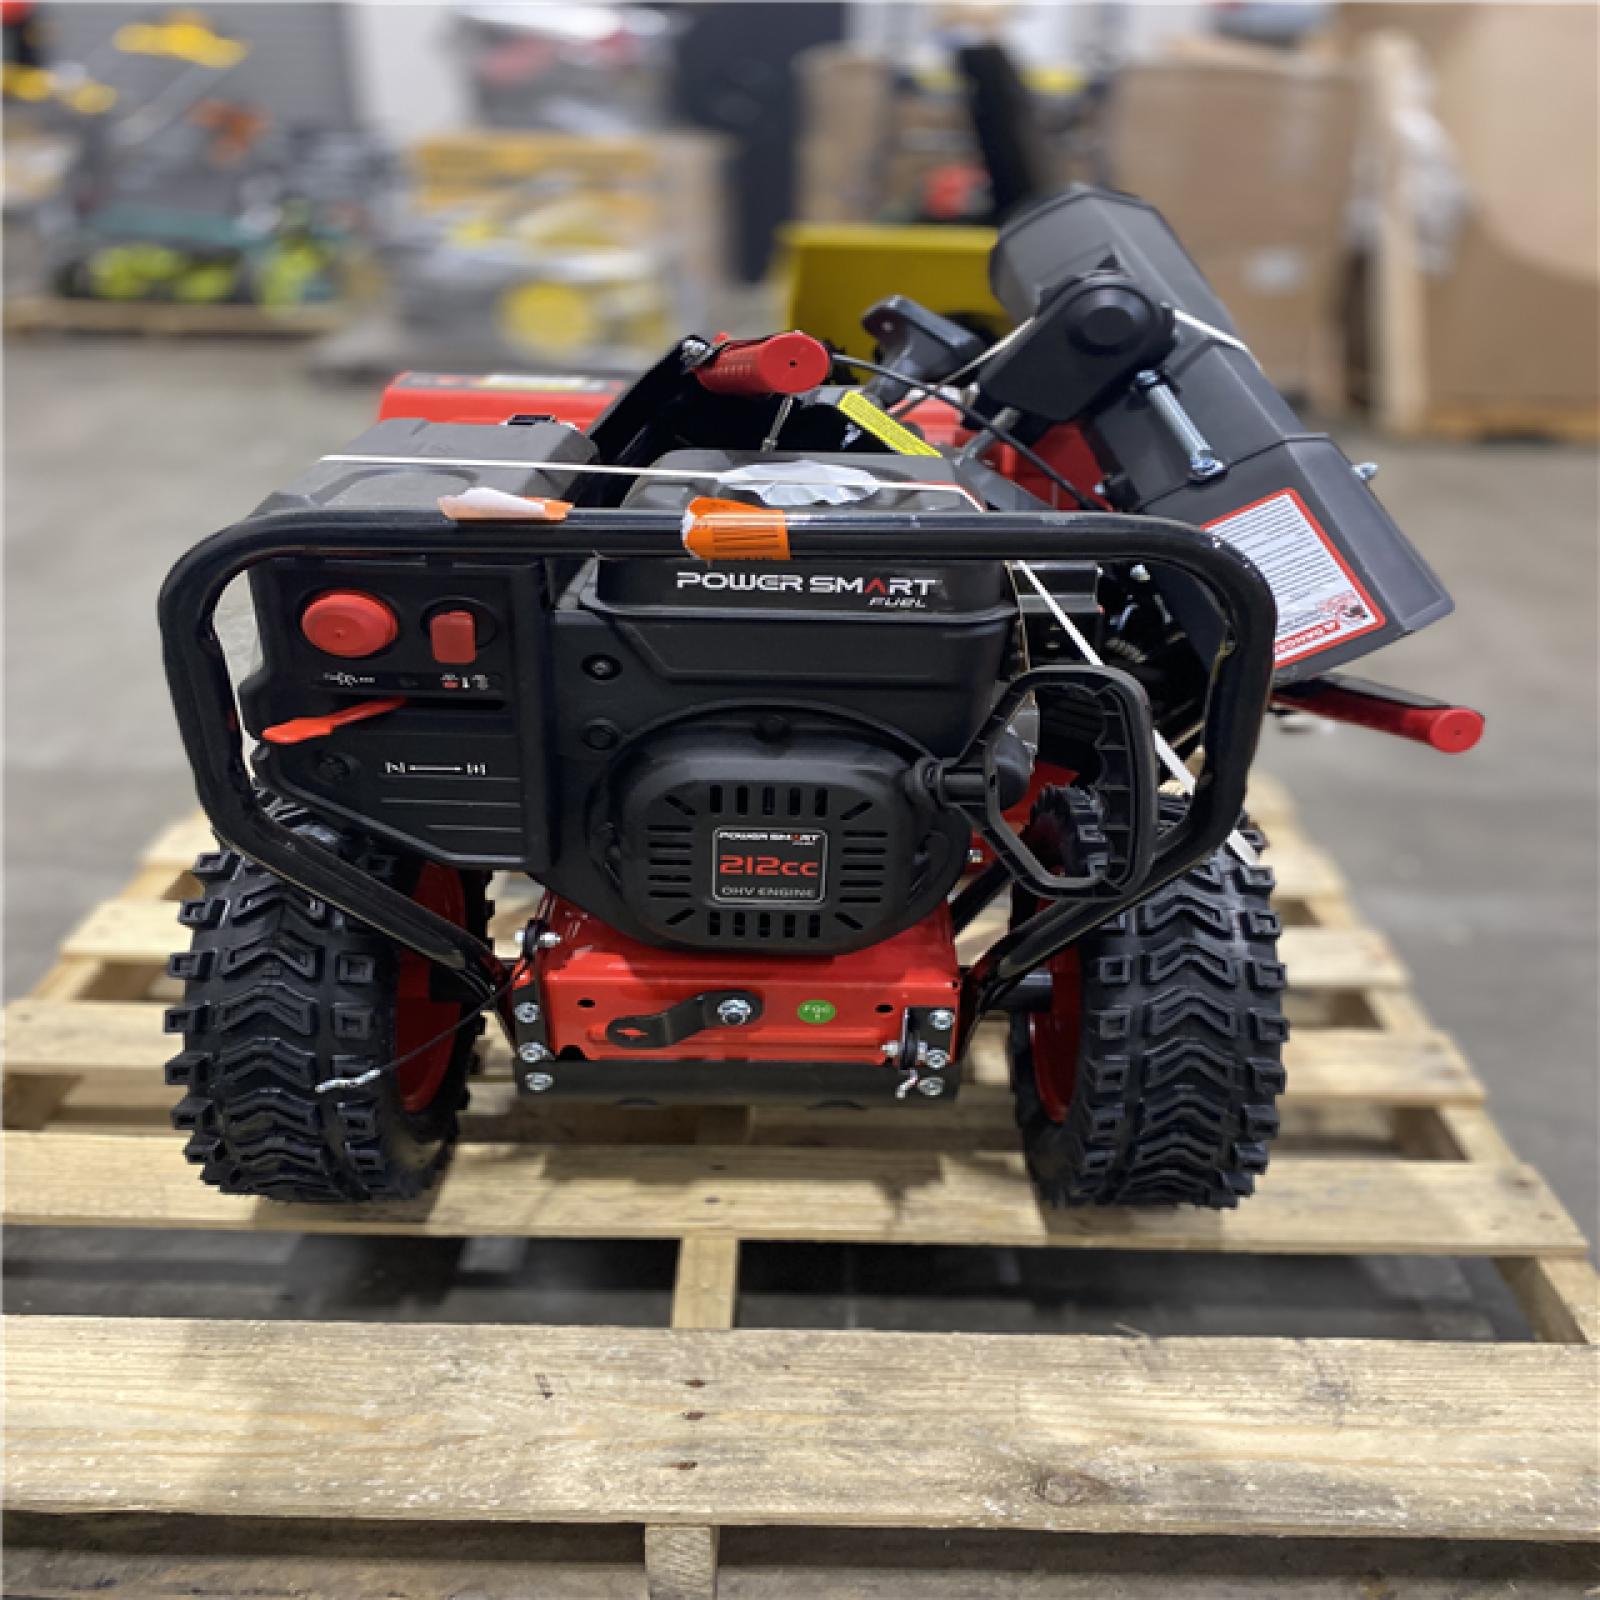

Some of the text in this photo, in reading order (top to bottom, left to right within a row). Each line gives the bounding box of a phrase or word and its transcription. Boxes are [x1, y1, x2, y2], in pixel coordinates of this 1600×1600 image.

[676, 571, 937, 597] POWER SMART
[719, 854, 819, 877] 212cc
